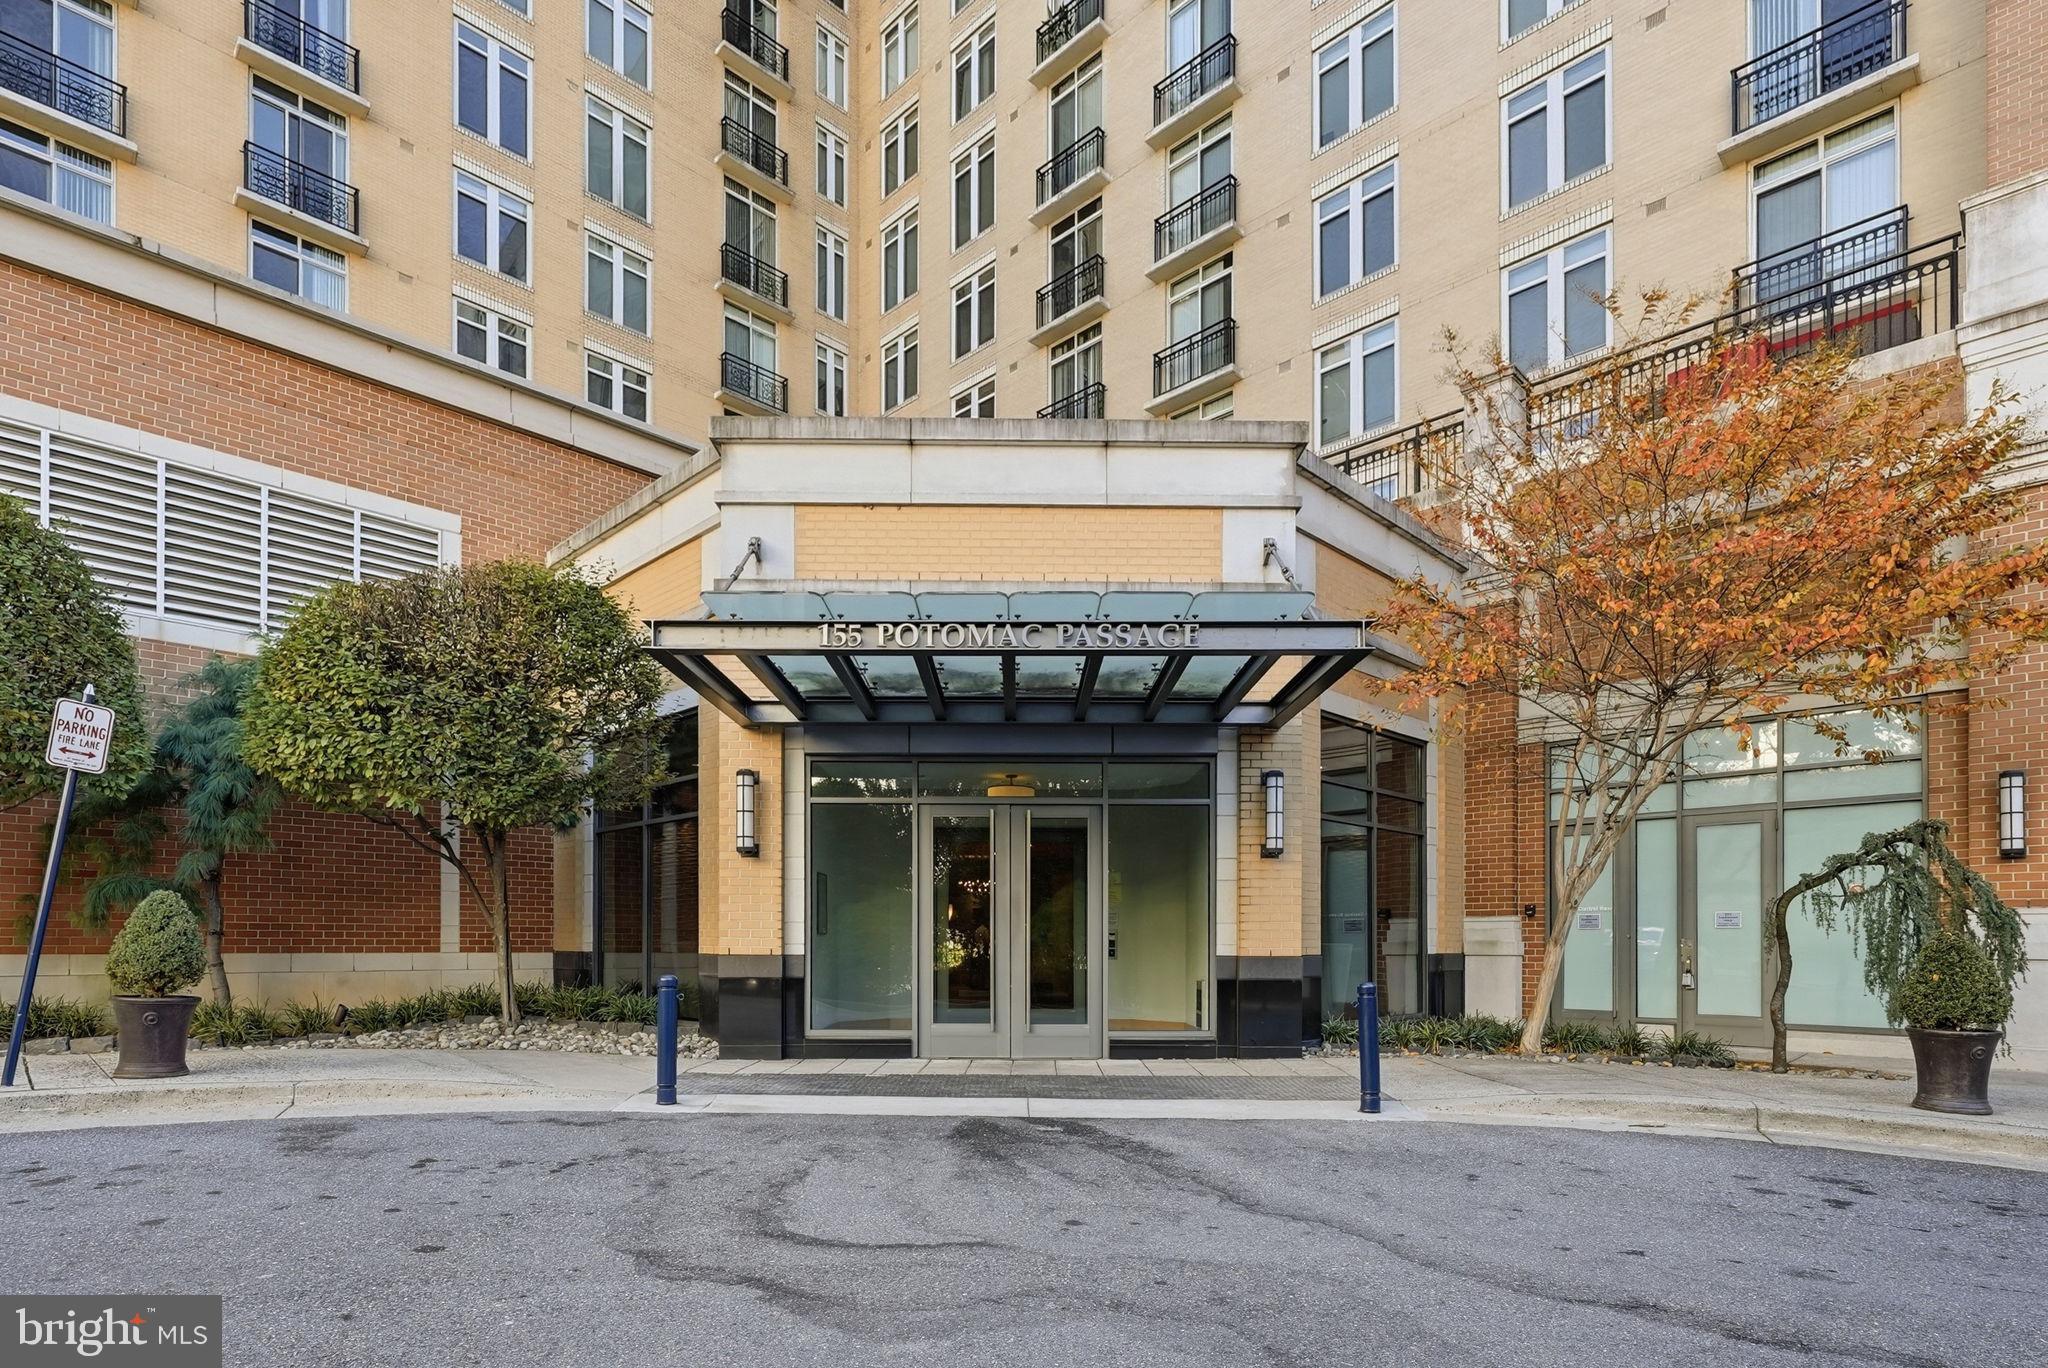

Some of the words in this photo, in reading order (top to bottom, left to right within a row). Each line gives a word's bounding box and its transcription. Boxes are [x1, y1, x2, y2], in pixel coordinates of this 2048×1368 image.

[818, 624, 863, 647] 155
[876, 623, 1043, 648] POTOMAC
[1056, 623, 1200, 648] PASSAGE
[74, 707, 95, 722] NO
[56, 719, 107, 740] PARKING
[58, 734, 76, 746] FIRE
[79, 738, 101, 751] LANE
